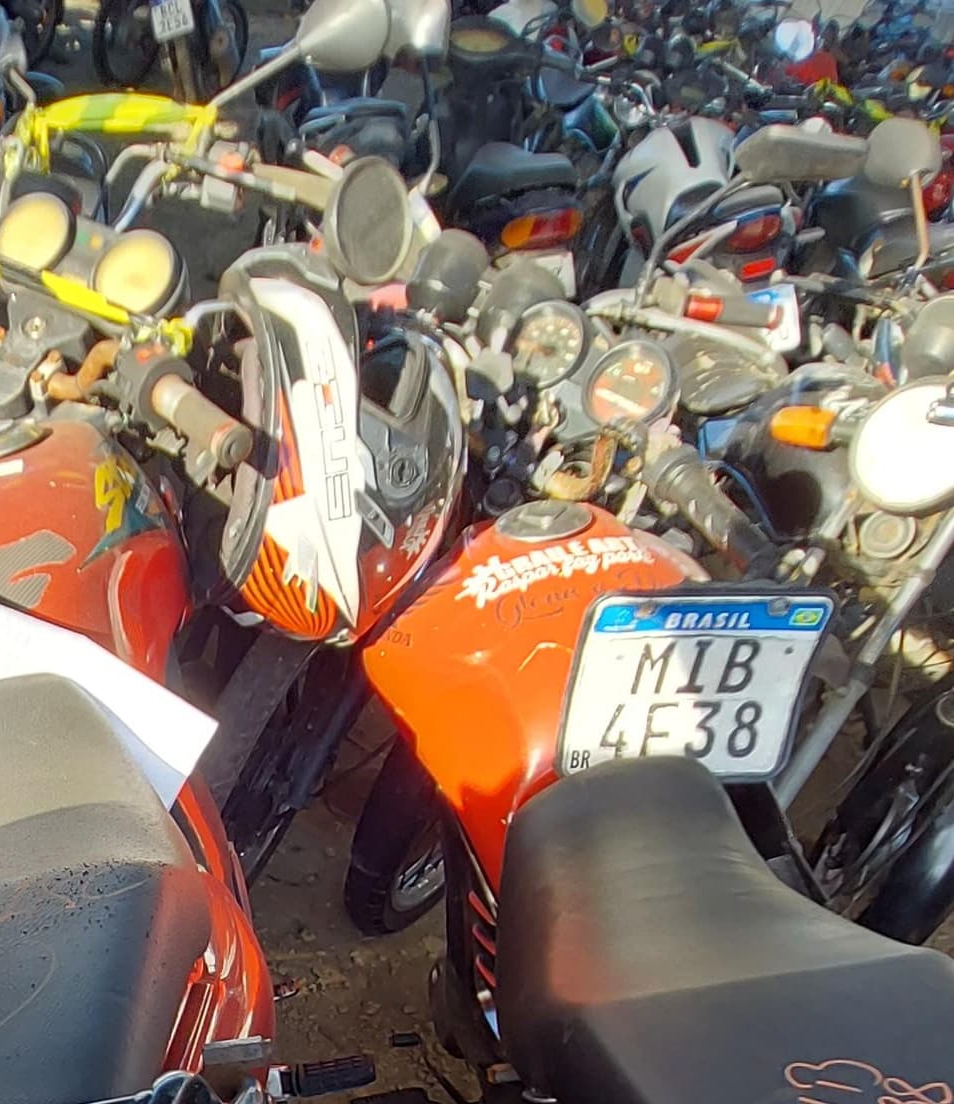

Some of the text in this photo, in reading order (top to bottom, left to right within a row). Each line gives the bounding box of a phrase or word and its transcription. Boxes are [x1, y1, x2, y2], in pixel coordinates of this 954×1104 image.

[663, 612, 752, 630] BRASIL
[630, 638, 761, 695] MIB
[599, 701, 762, 759] 4F38
[569, 750, 591, 769] BR
